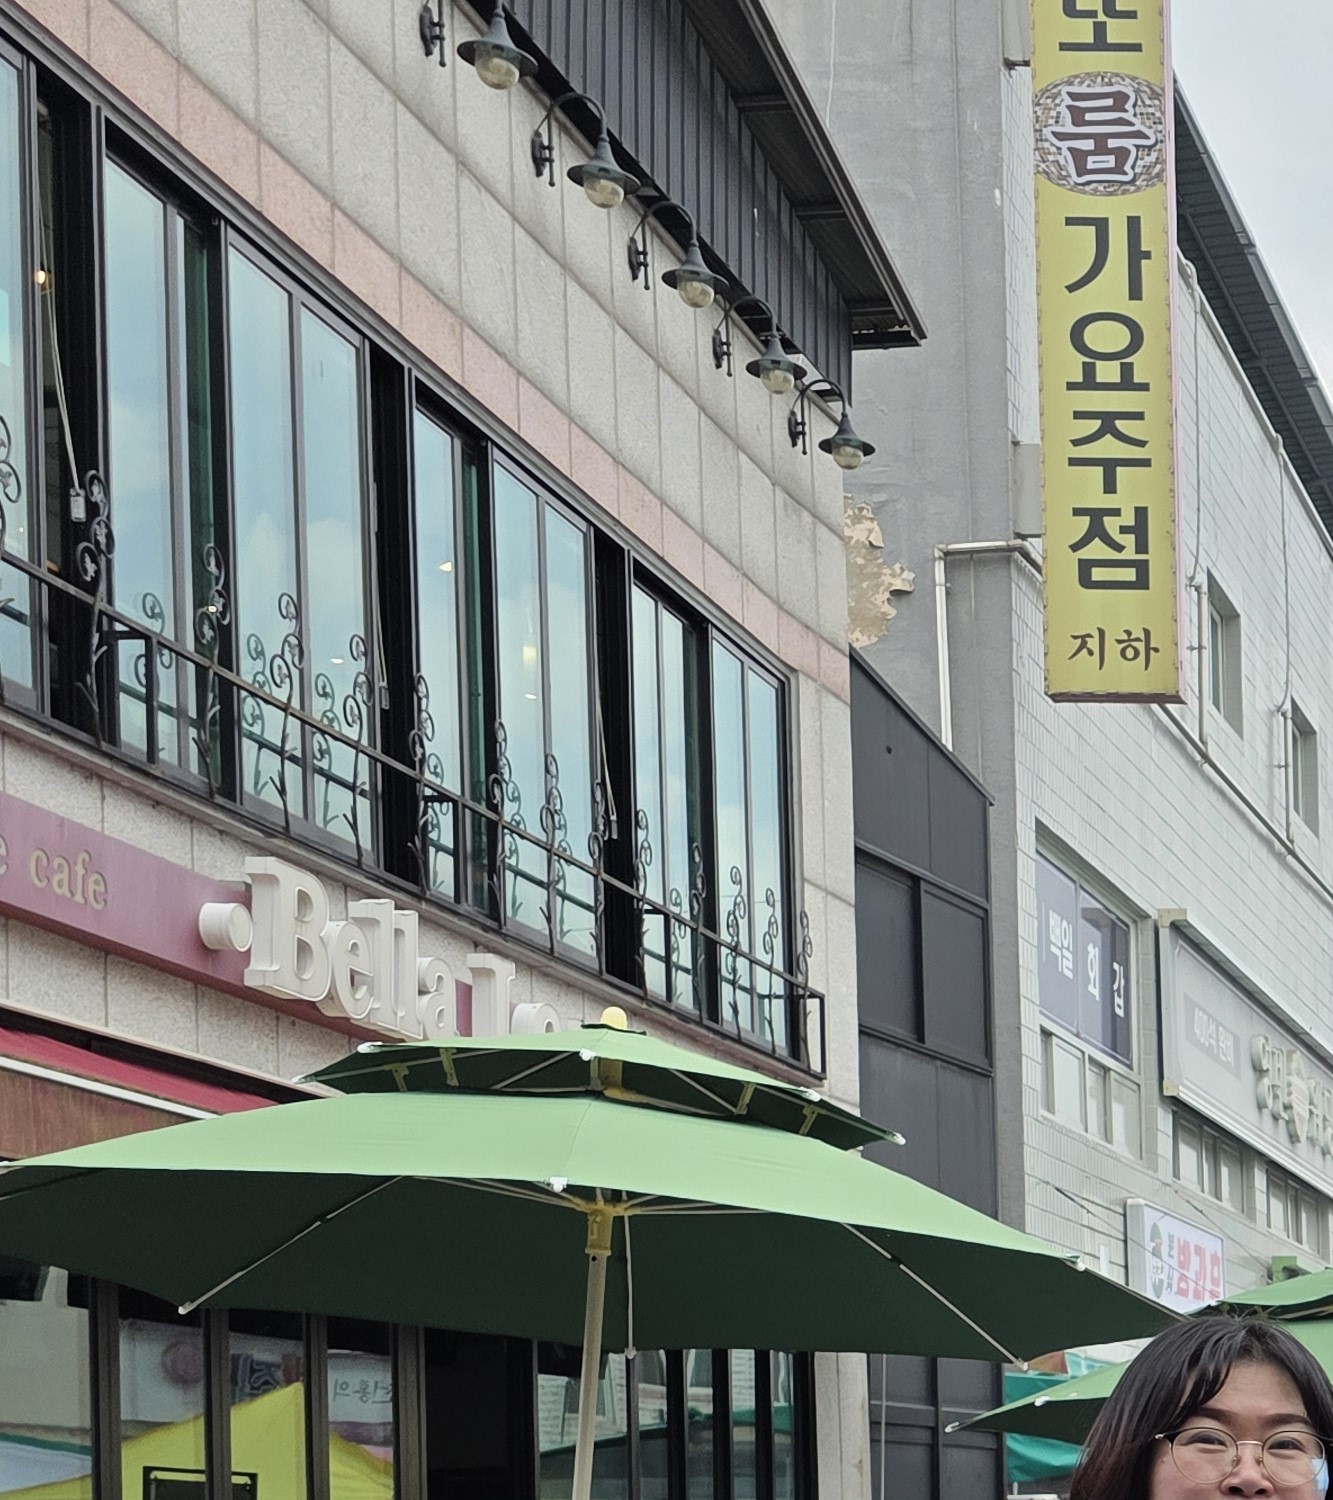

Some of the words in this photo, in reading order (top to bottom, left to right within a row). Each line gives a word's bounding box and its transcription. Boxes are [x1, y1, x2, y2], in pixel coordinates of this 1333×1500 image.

[1064, 215, 1152, 590] 가요주점
[1068, 625, 1160, 672] 지하
[30, 847, 109, 911] cafe
[243, 856, 457, 1039] Bella
[1049, 909, 1074, 980] 백일
